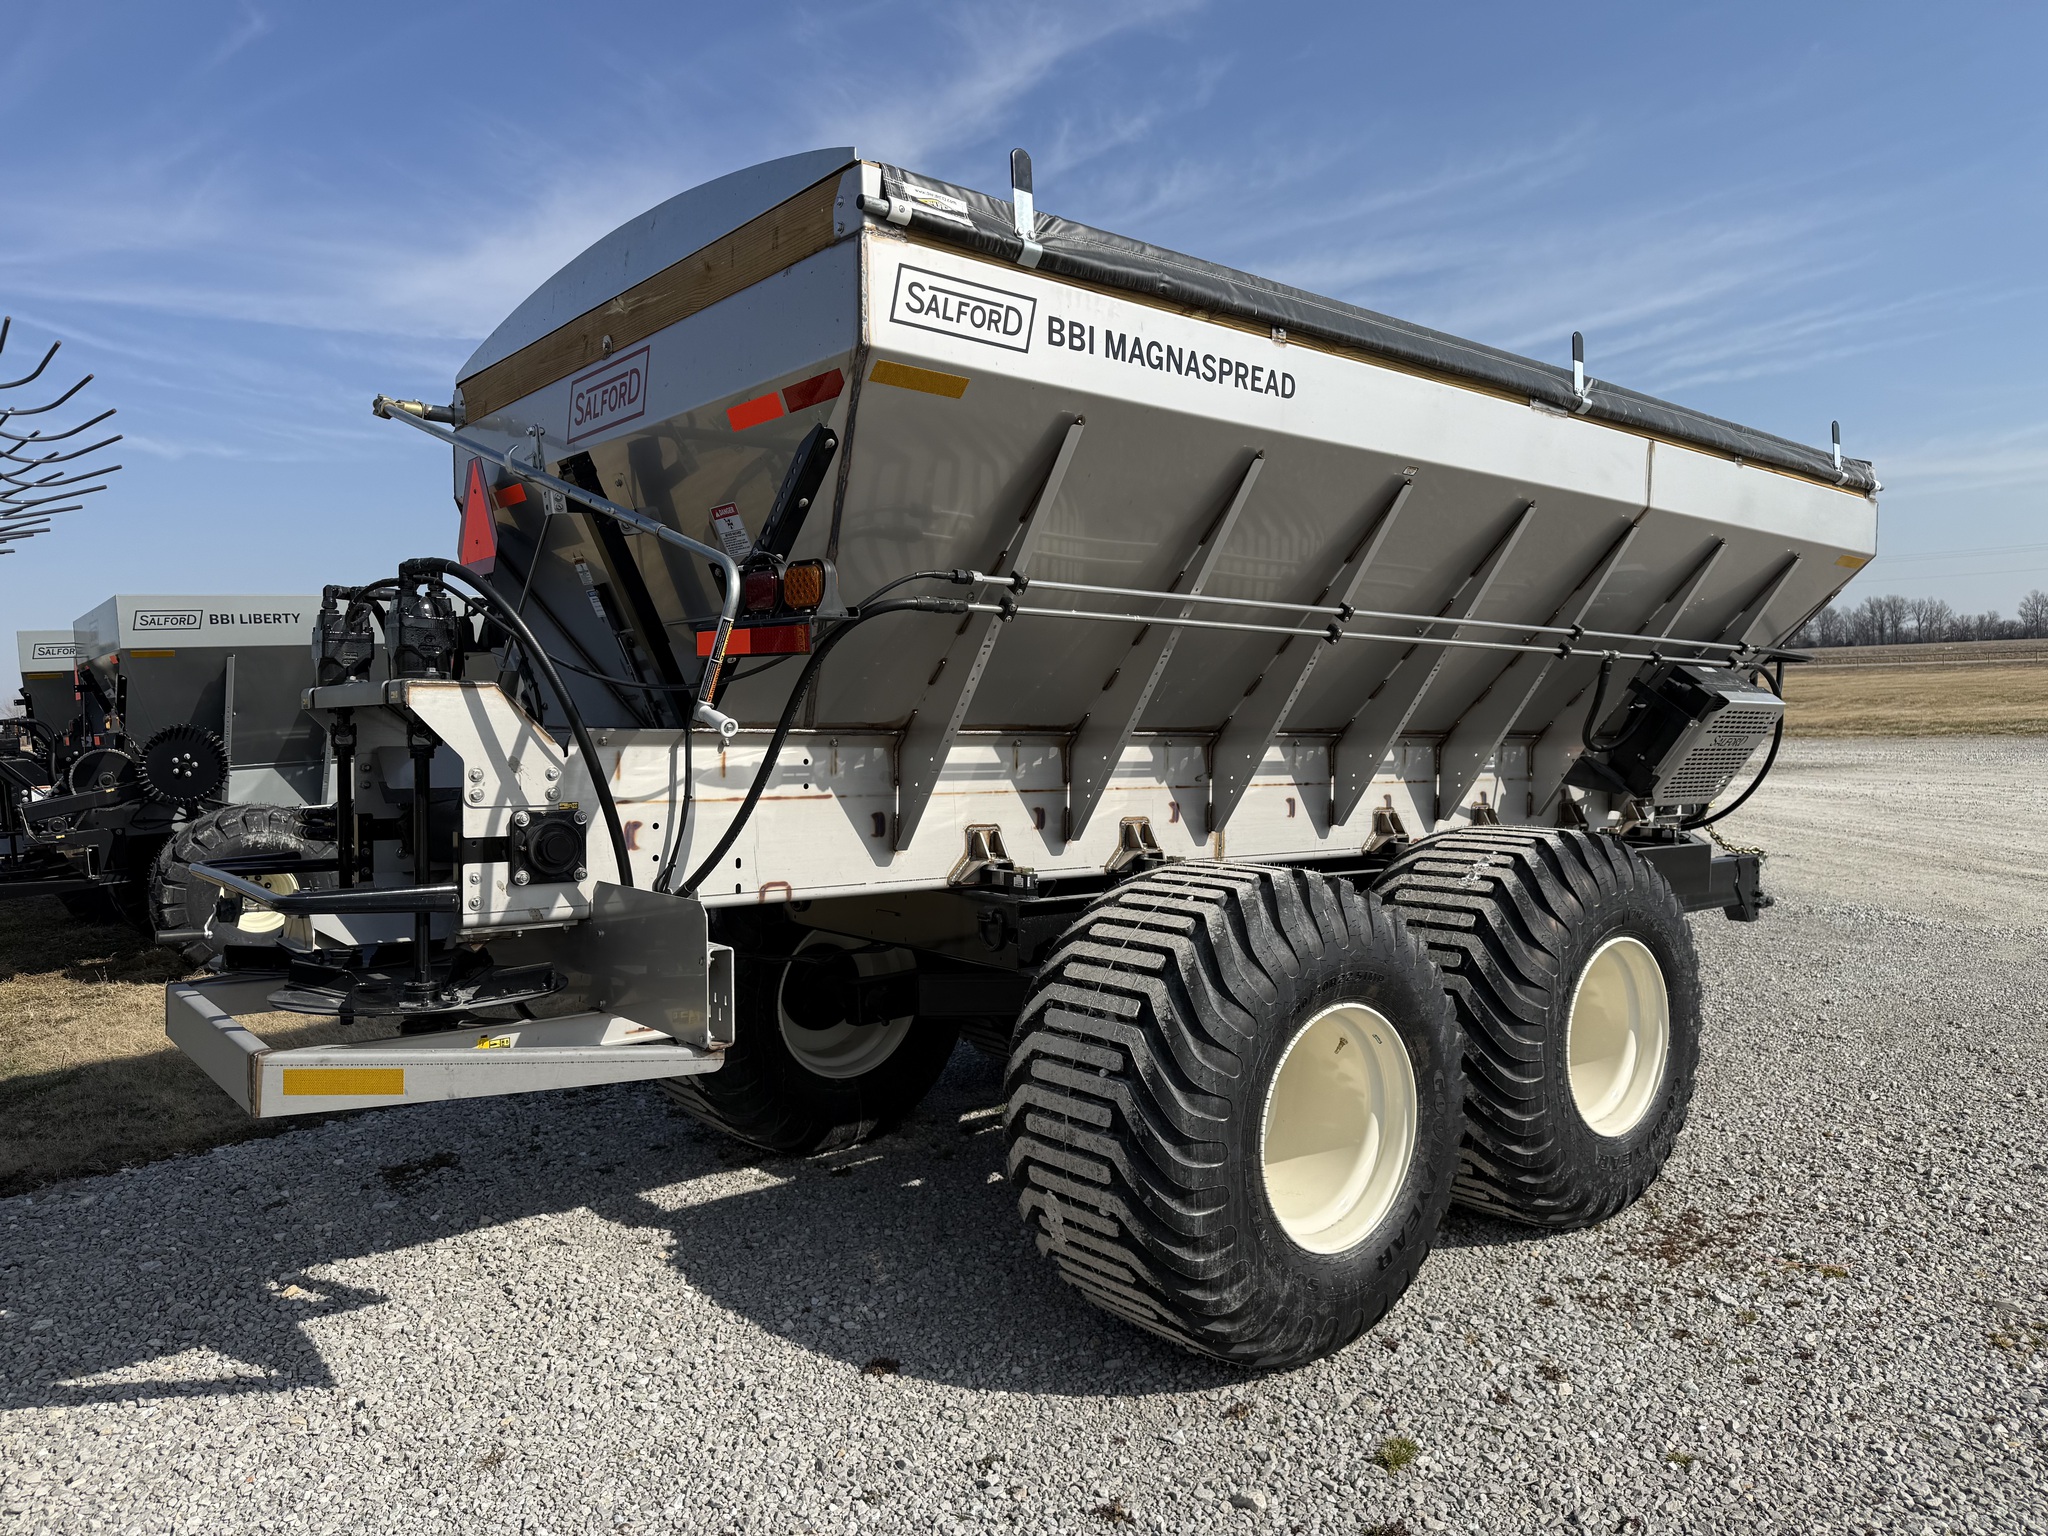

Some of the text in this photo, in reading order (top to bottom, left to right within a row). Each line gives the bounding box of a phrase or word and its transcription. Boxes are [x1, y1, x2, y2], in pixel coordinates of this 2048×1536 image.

[905, 281, 1023, 337] SALFORD
[1047, 315, 1297, 400] BBI MAGNASPREAD
[574, 367, 641, 426] SALFORD
[139, 614, 197, 626] SALFORD
[209, 612, 301, 625] BBI LIBERTY
[37, 646, 76, 656] SALFOR
[1709, 735, 1749, 747] SALFORD
[1375, 1068, 1447, 1272] GOODYEAR
